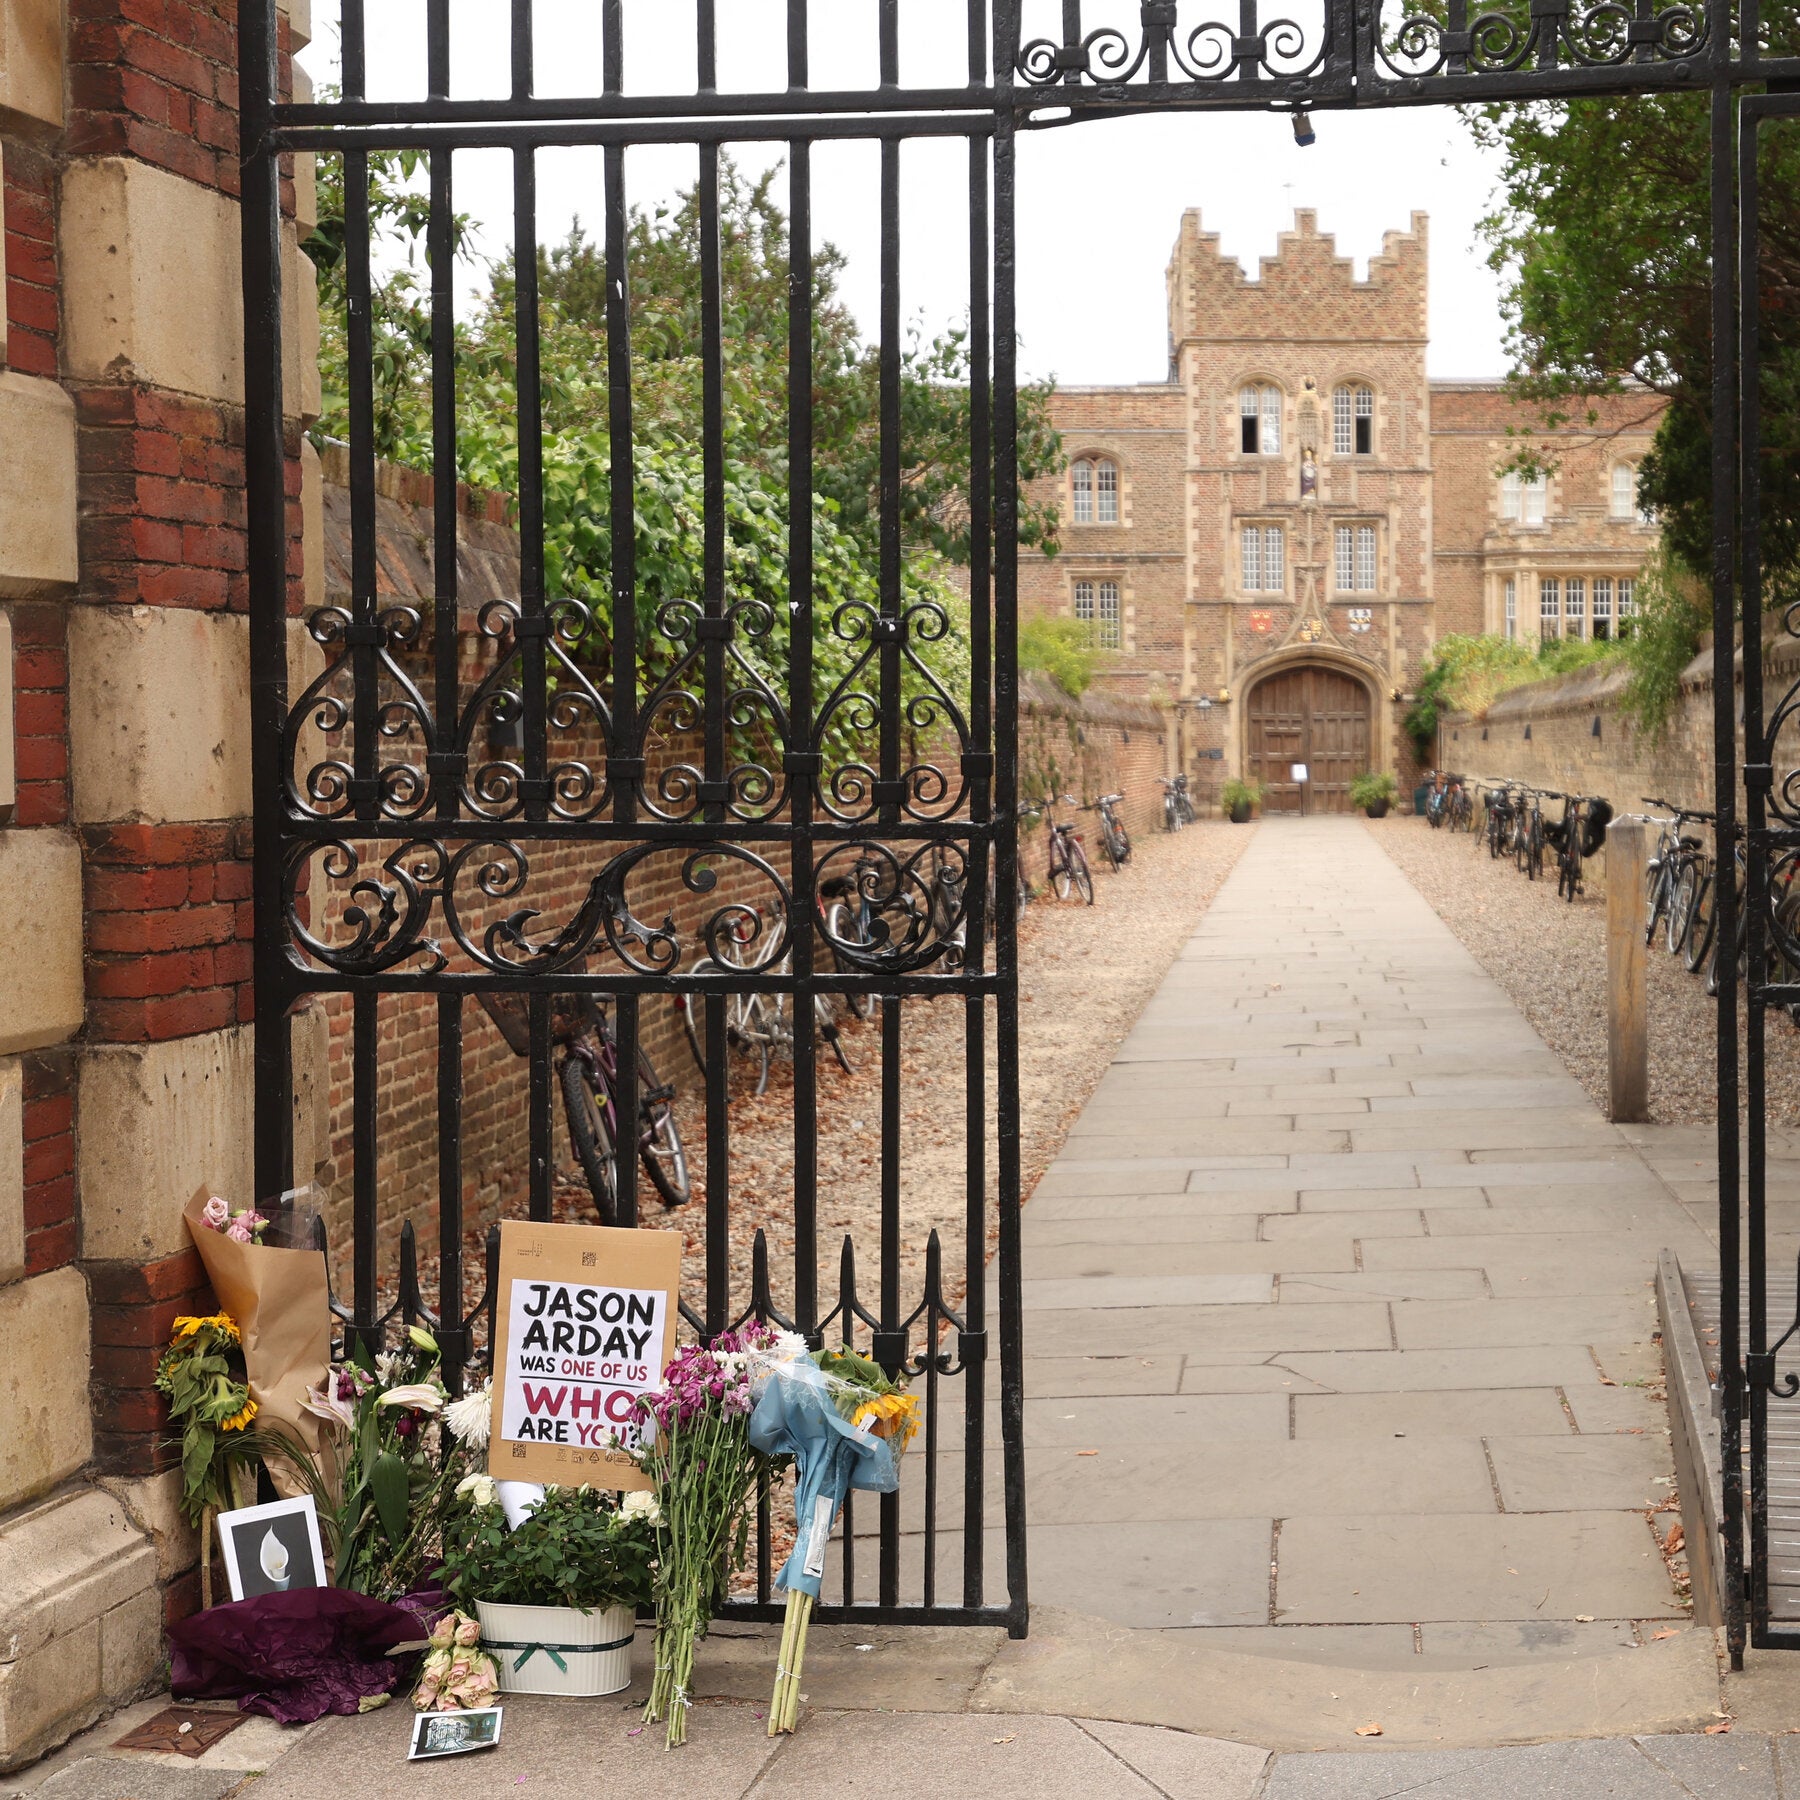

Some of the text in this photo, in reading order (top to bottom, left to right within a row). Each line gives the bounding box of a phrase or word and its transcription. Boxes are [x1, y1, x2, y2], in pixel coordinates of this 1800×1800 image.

[523, 1285, 655, 1326] JASON
[521, 1319, 653, 1360] ARDAY
[520, 1355, 648, 1381] WAS ONE OF US
[523, 1382, 636, 1423] WHO
[517, 1417, 569, 1442] ARE
